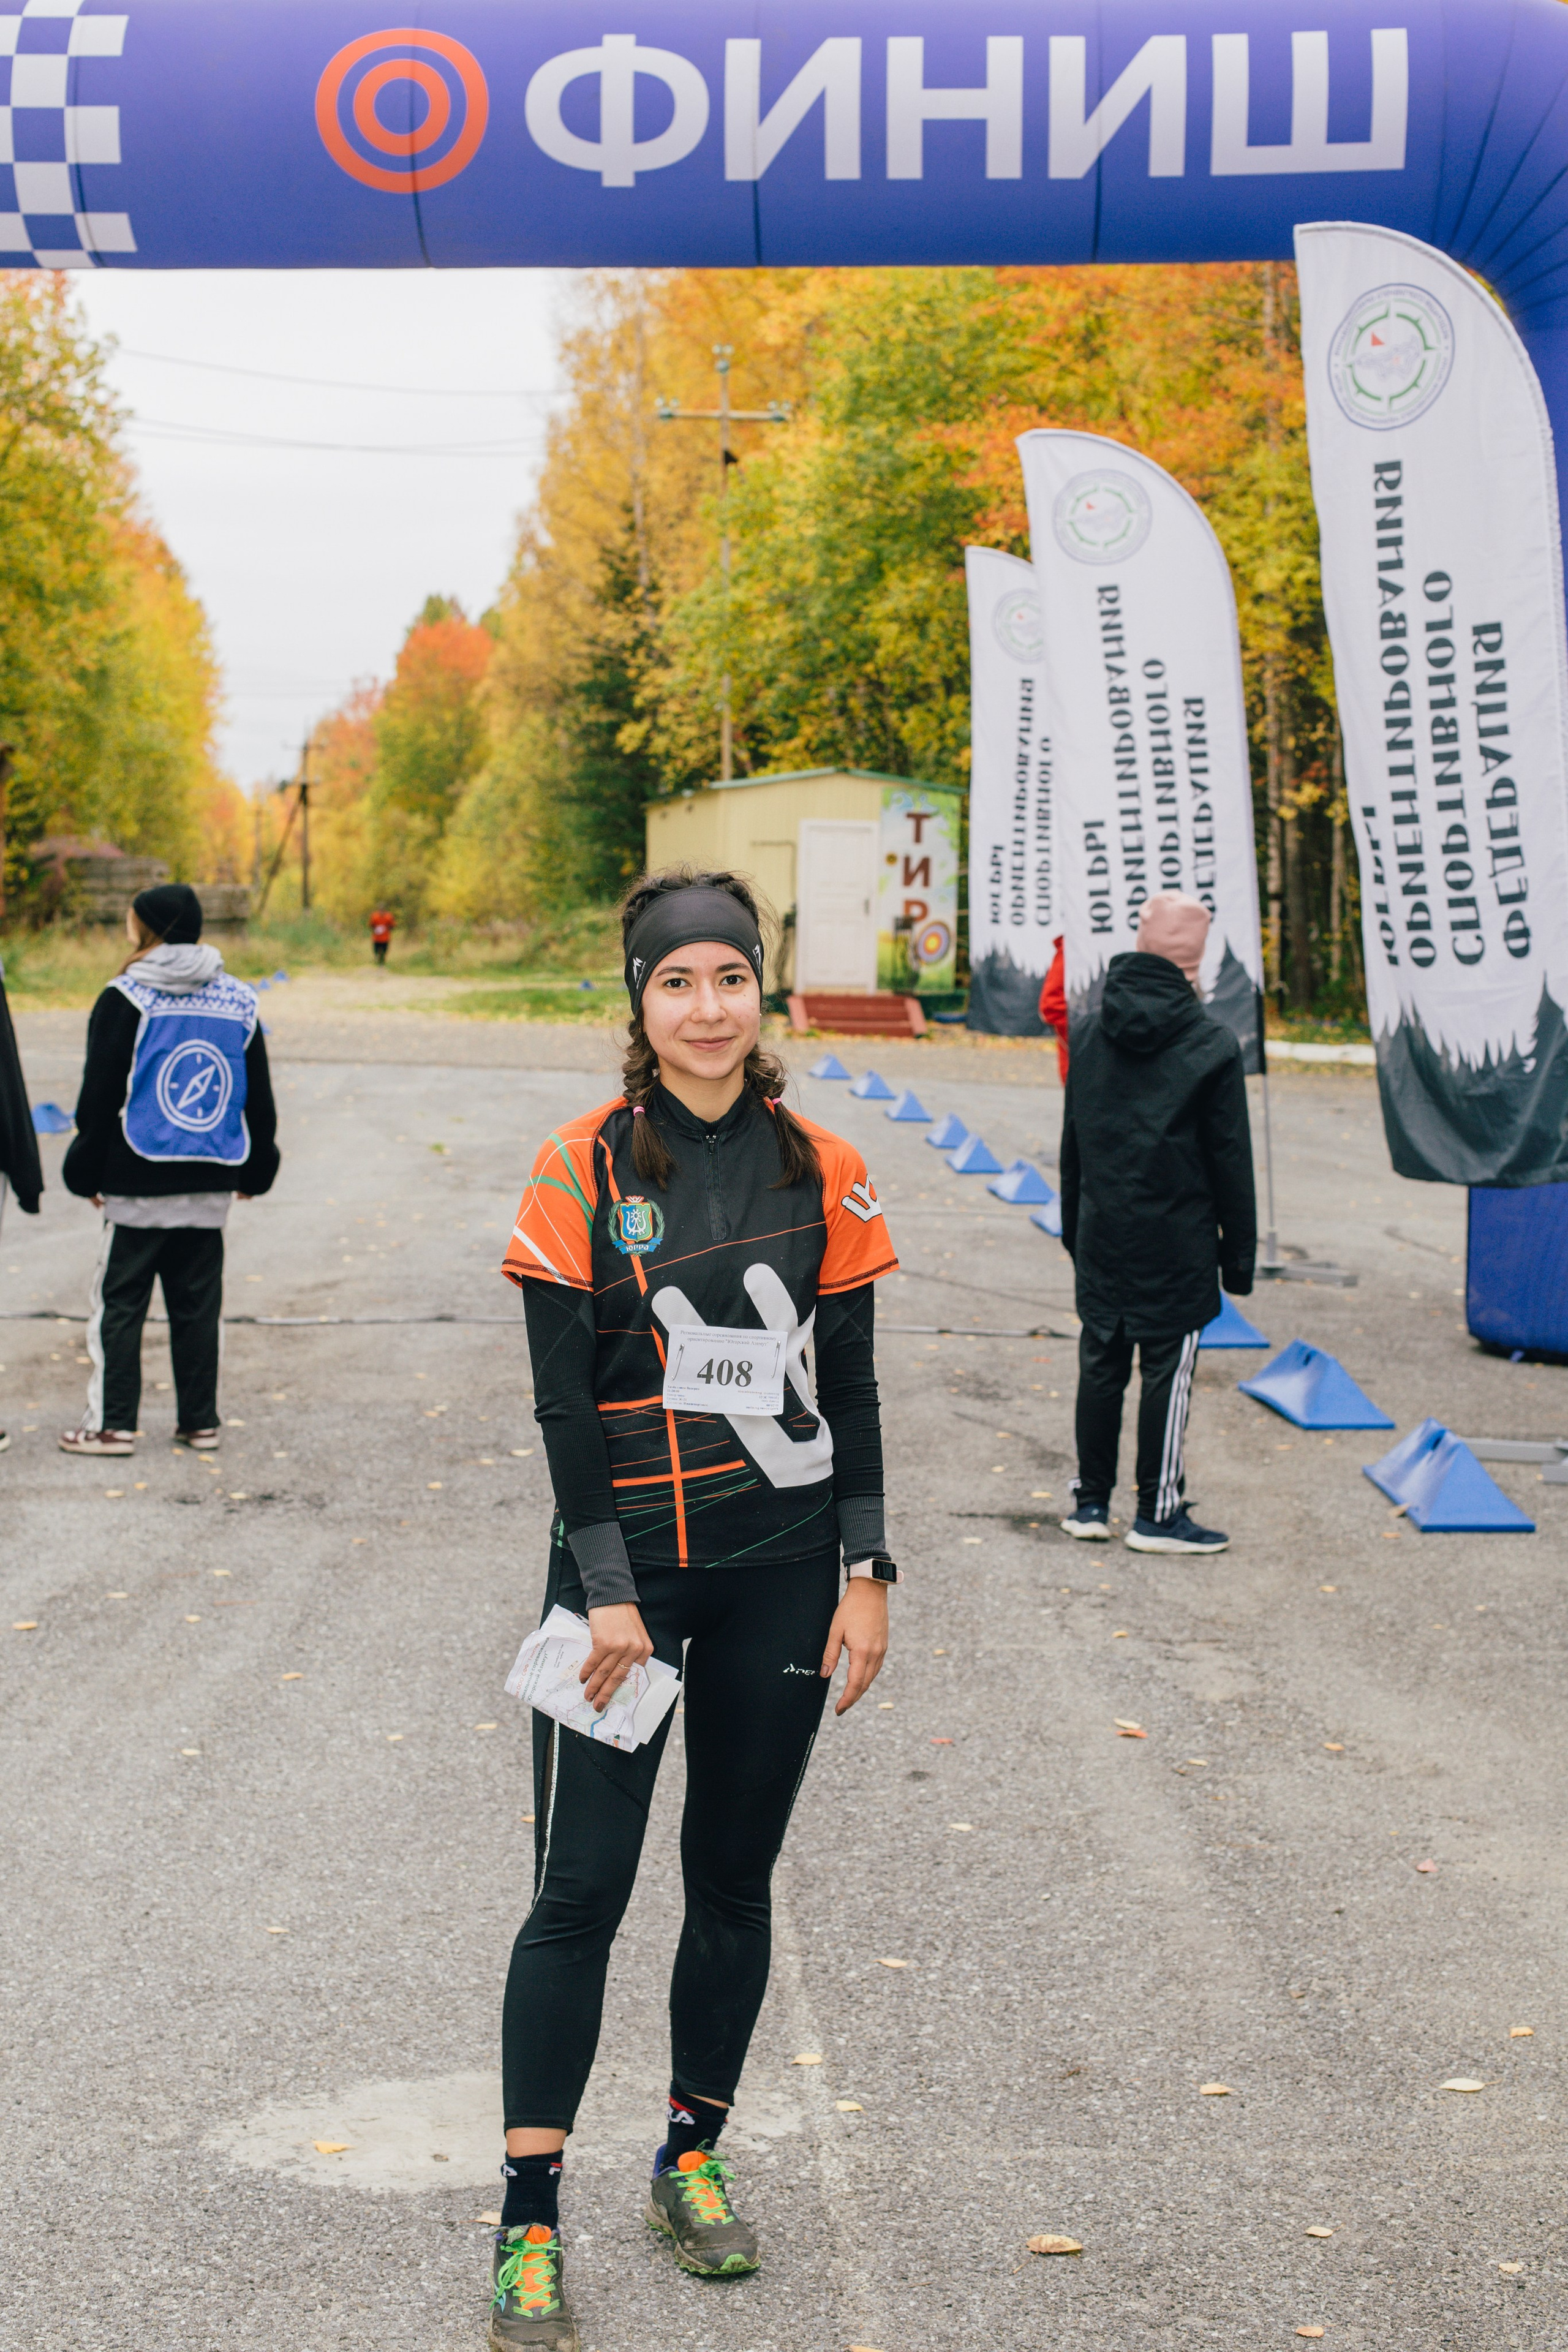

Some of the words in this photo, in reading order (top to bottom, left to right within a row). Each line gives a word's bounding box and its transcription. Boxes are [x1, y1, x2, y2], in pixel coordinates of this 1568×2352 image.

[524, 28, 1408, 187] ФИНИШ
[903, 812, 932, 923] ТИР
[696, 1358, 753, 1387] 408
